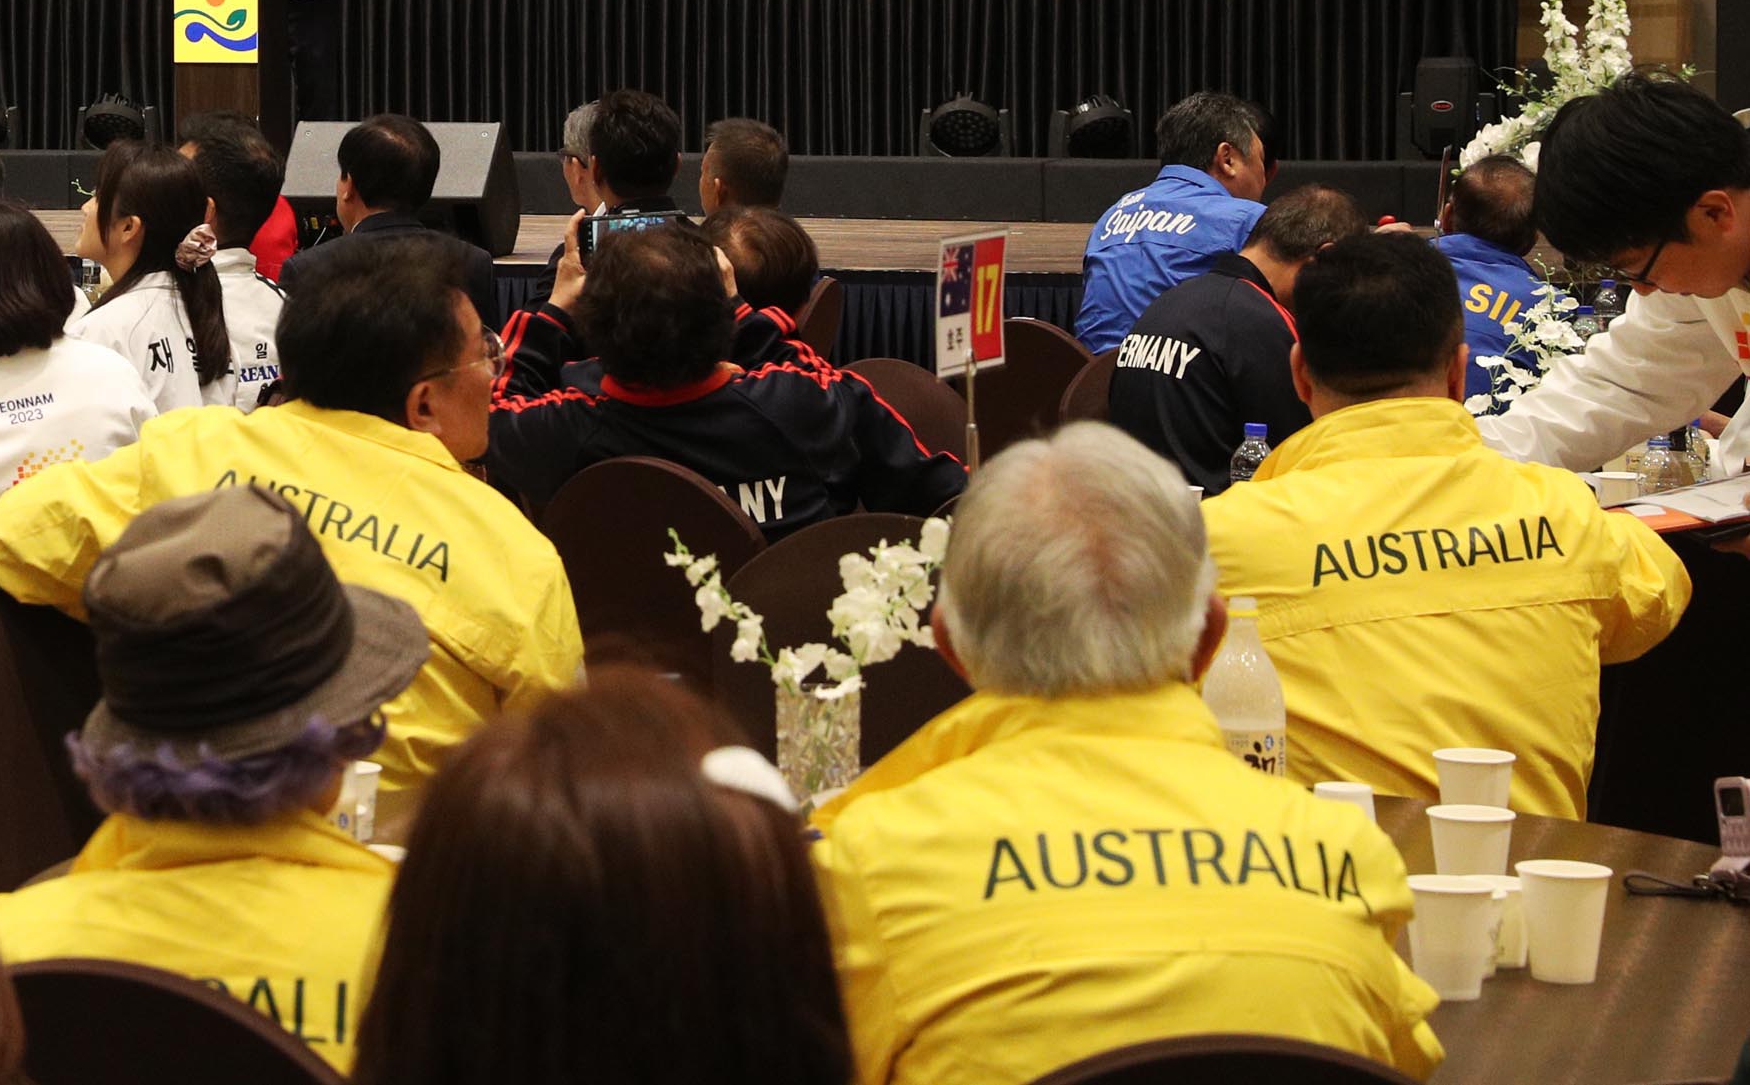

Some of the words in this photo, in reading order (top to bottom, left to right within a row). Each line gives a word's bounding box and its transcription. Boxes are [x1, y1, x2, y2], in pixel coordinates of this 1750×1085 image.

[1101, 204, 1197, 243] Saipan
[977, 264, 1000, 335] 17
[9, 408, 43, 425] 2023
[1313, 516, 1564, 587] AUSTRALIA
[983, 829, 1373, 915] AUSTRALIA
